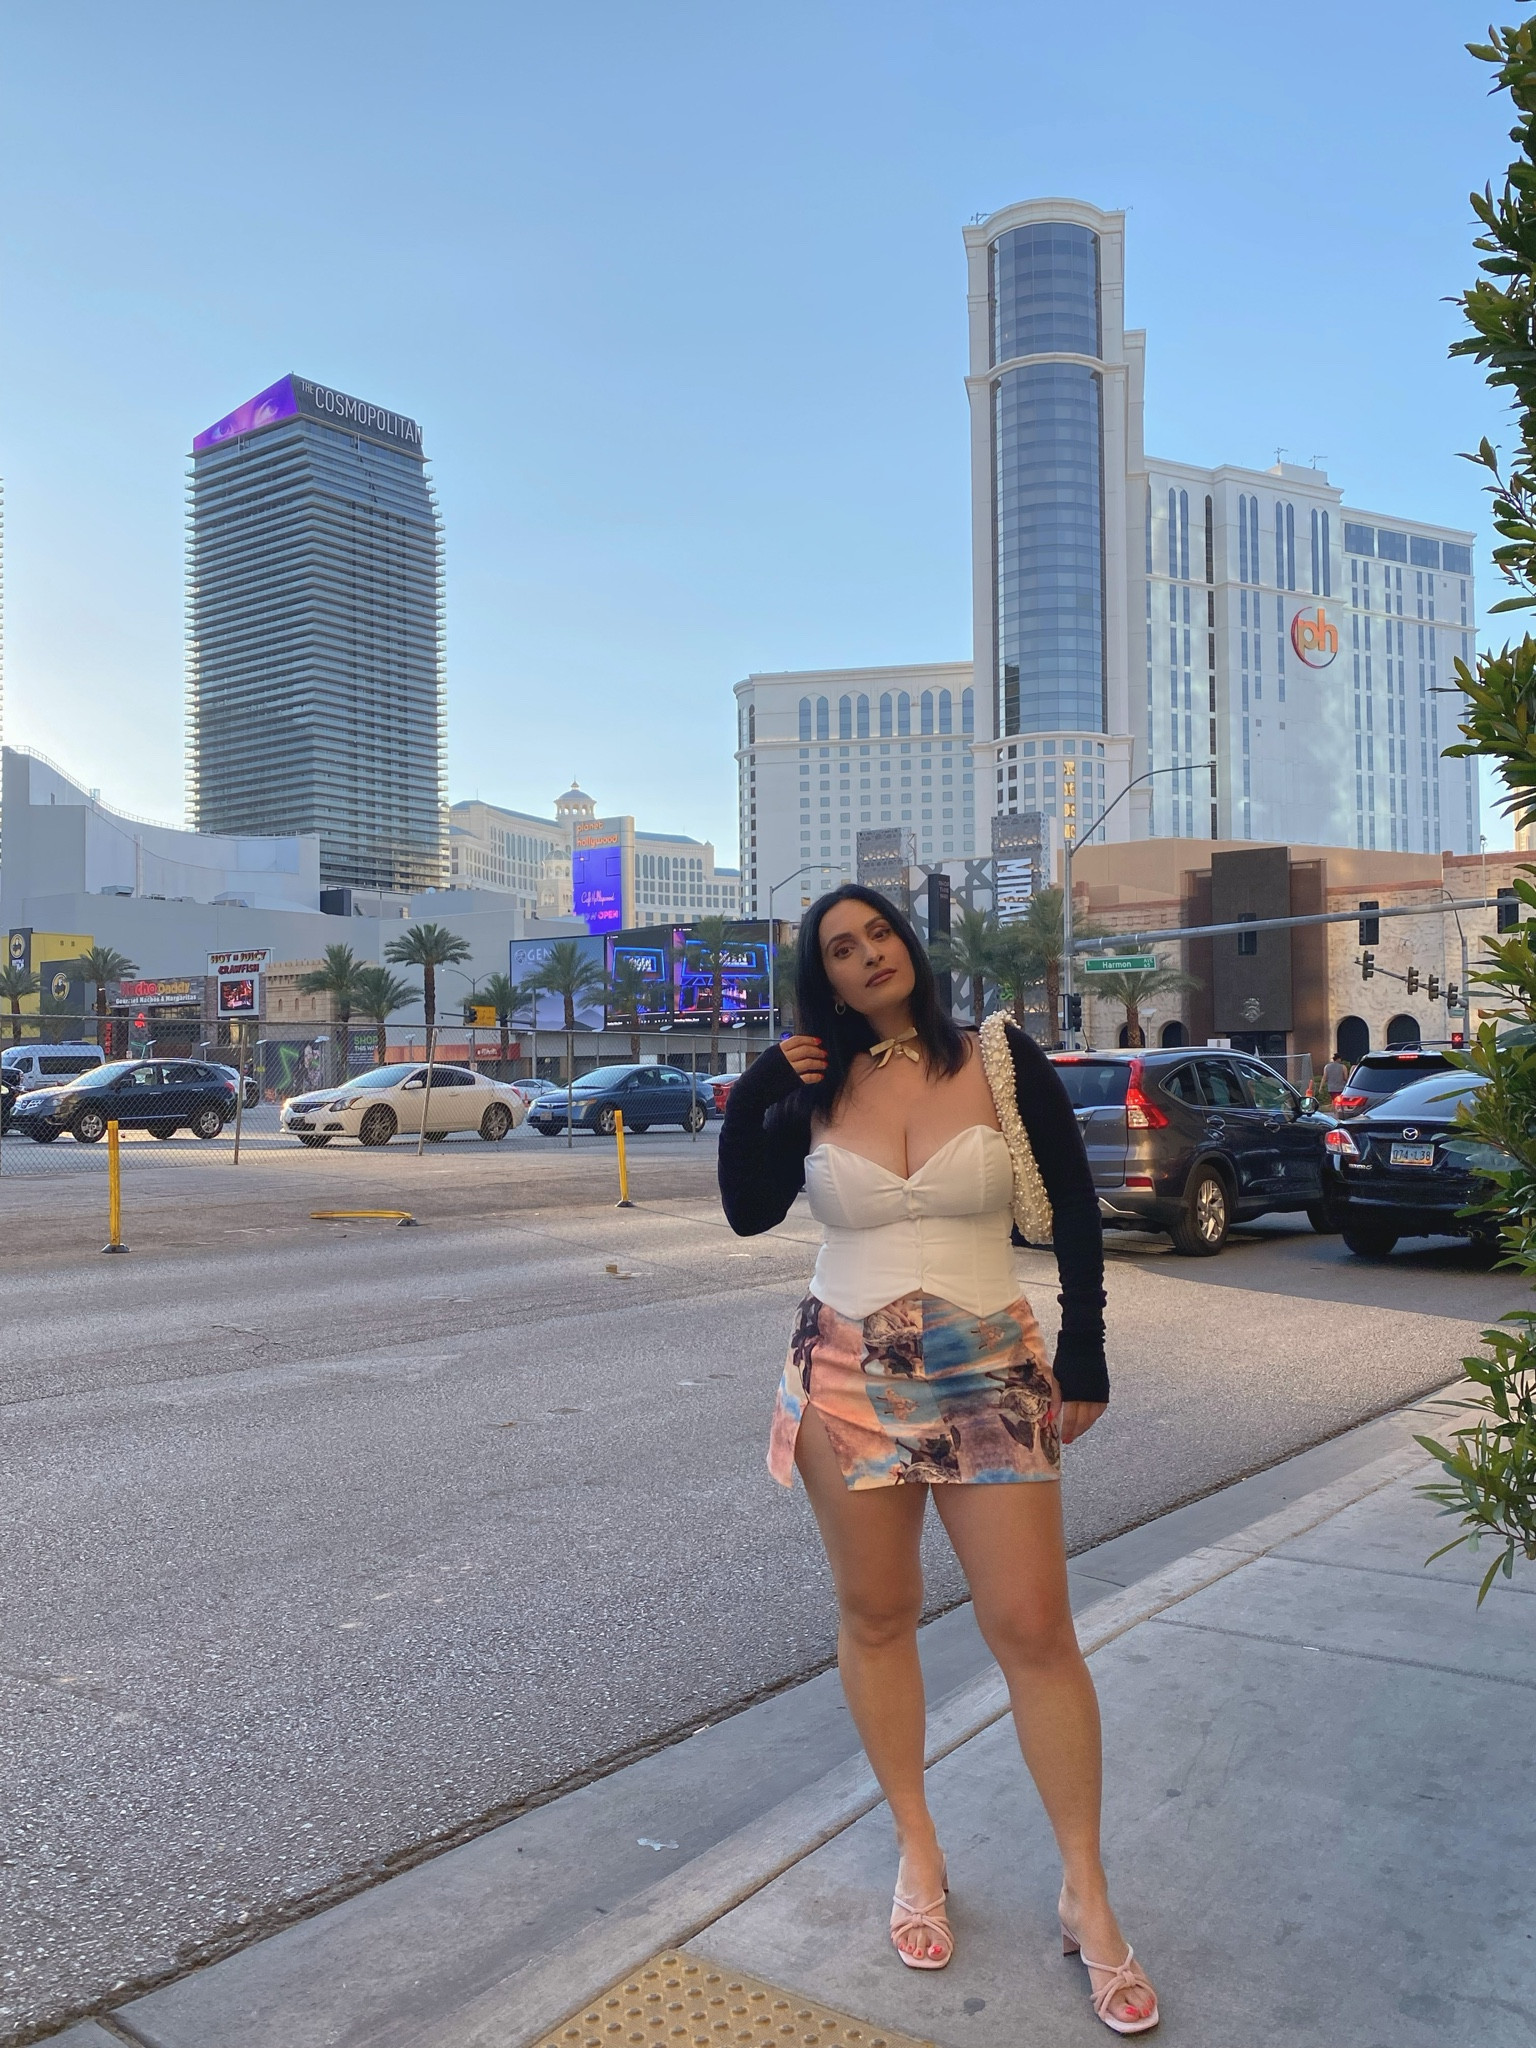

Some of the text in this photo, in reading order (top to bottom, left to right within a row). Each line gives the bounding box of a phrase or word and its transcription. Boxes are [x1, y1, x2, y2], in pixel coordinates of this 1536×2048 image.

[301, 380, 424, 446] THE COSMOPOLITAN
[1297, 607, 1339, 659] ph
[576, 821, 604, 836] planet
[576, 834, 619, 848] hollywood
[597, 909, 619, 920] OPEN
[210, 953, 232, 964] HOT
[240, 951, 267, 962] JUICY
[218, 963, 260, 975] CRAWFISH
[1102, 961, 1132, 969] Harmon
[158, 981, 191, 994] Daddy
[140, 996, 160, 1004] Nachos
[165, 994, 197, 1003] Margaritas
